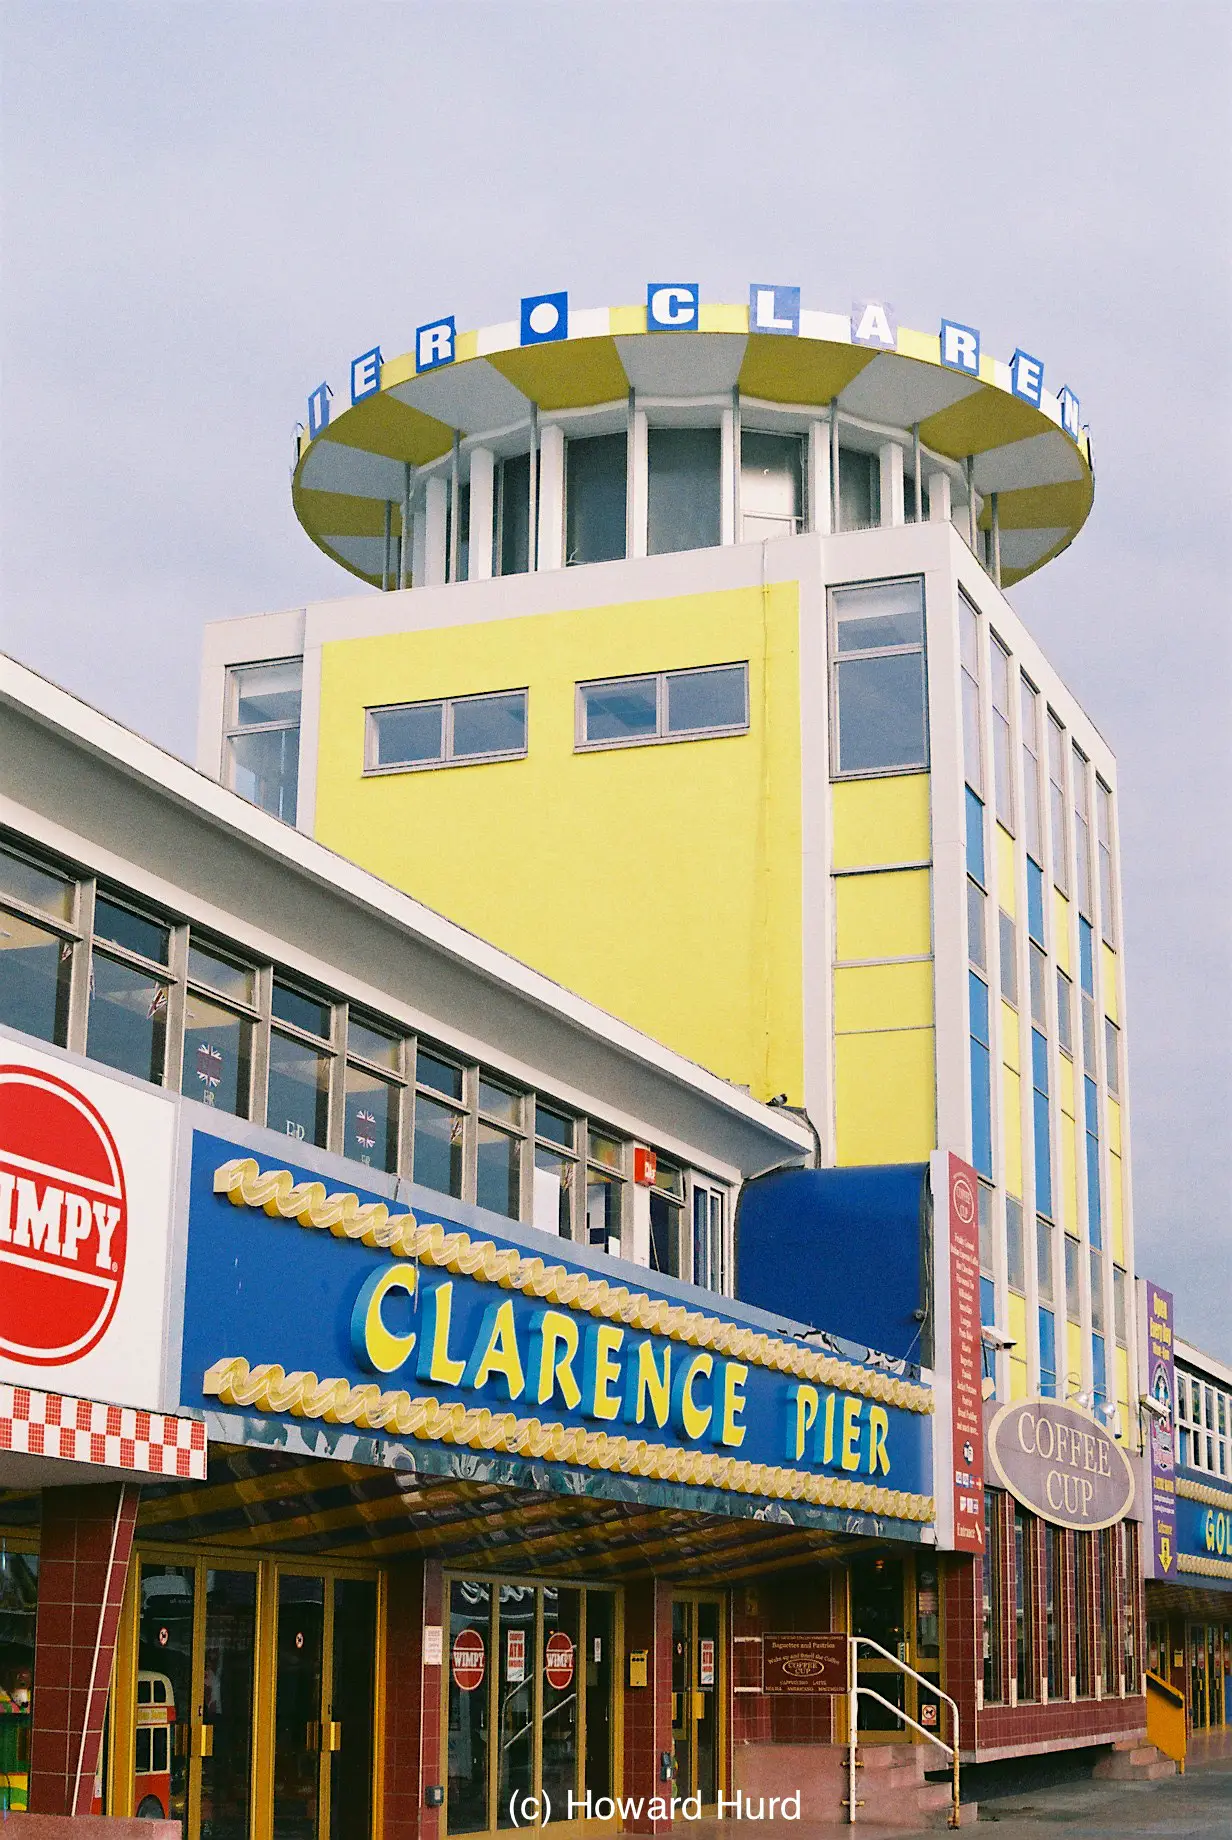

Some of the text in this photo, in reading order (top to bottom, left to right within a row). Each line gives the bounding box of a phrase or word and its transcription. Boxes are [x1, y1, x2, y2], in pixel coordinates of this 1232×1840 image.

[361, 1263, 890, 1476] CLARENCE PIER
[1017, 1411, 1111, 1478] COFFEE
[1046, 1469, 1093, 1517] CUP
[453, 1651, 484, 1667] WIMPY
[546, 1653, 573, 1667] WIMPY
